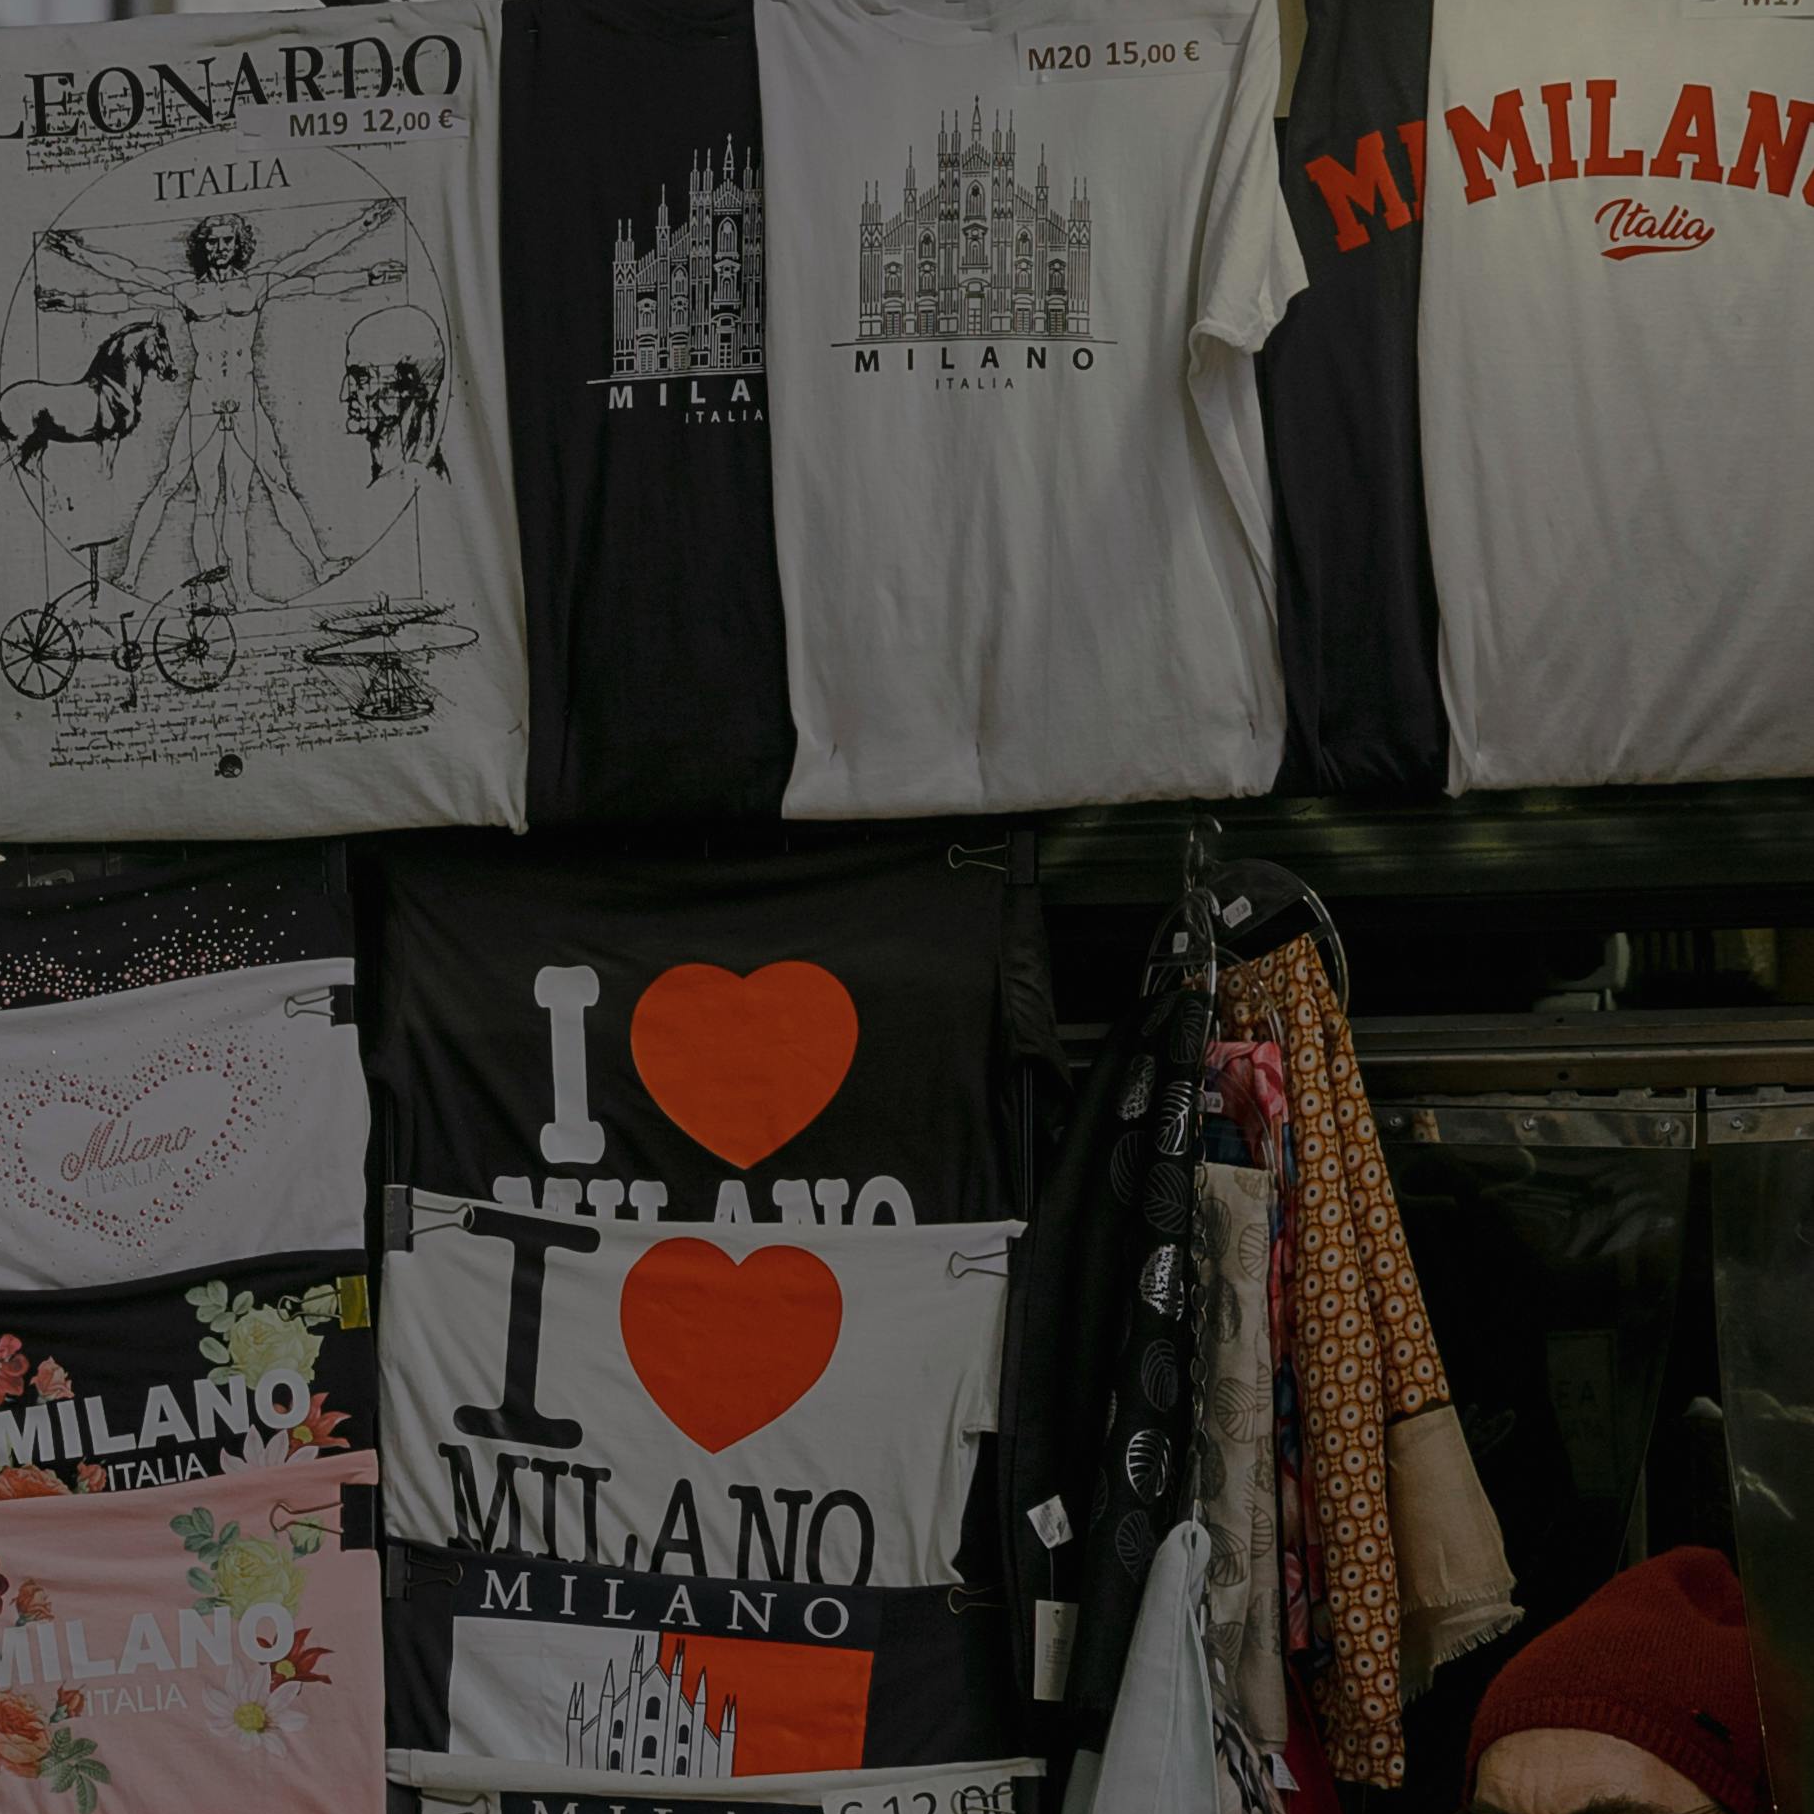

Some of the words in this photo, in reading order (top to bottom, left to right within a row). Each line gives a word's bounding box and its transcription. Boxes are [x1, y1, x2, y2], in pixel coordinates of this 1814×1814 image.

[1027, 43, 1092, 71] M20
[1105, 40, 1176, 68] 15,00
[1183, 40, 1201, 62] €
[289, 111, 348, 138] M19
[362, 106, 432, 135] 12,00
[438, 108, 454, 129] €
[1444, 79, 1814, 210] MILAN
[154, 158, 292, 202] ITALIA
[1594, 198, 1715, 261] Italia
[855, 346, 1095, 374] MILANO
[935, 376, 1015, 391] ITALIA
[685, 409, 765, 425] ITALIA
[533, 965, 606, 1164] I
[452, 1206, 601, 1449] I
[107, 1452, 209, 1491] ITALIA
[438, 1442, 875, 1587] MILANO
[480, 1568, 852, 1641] MILANO
[86, 1683, 188, 1719] ITALIA
